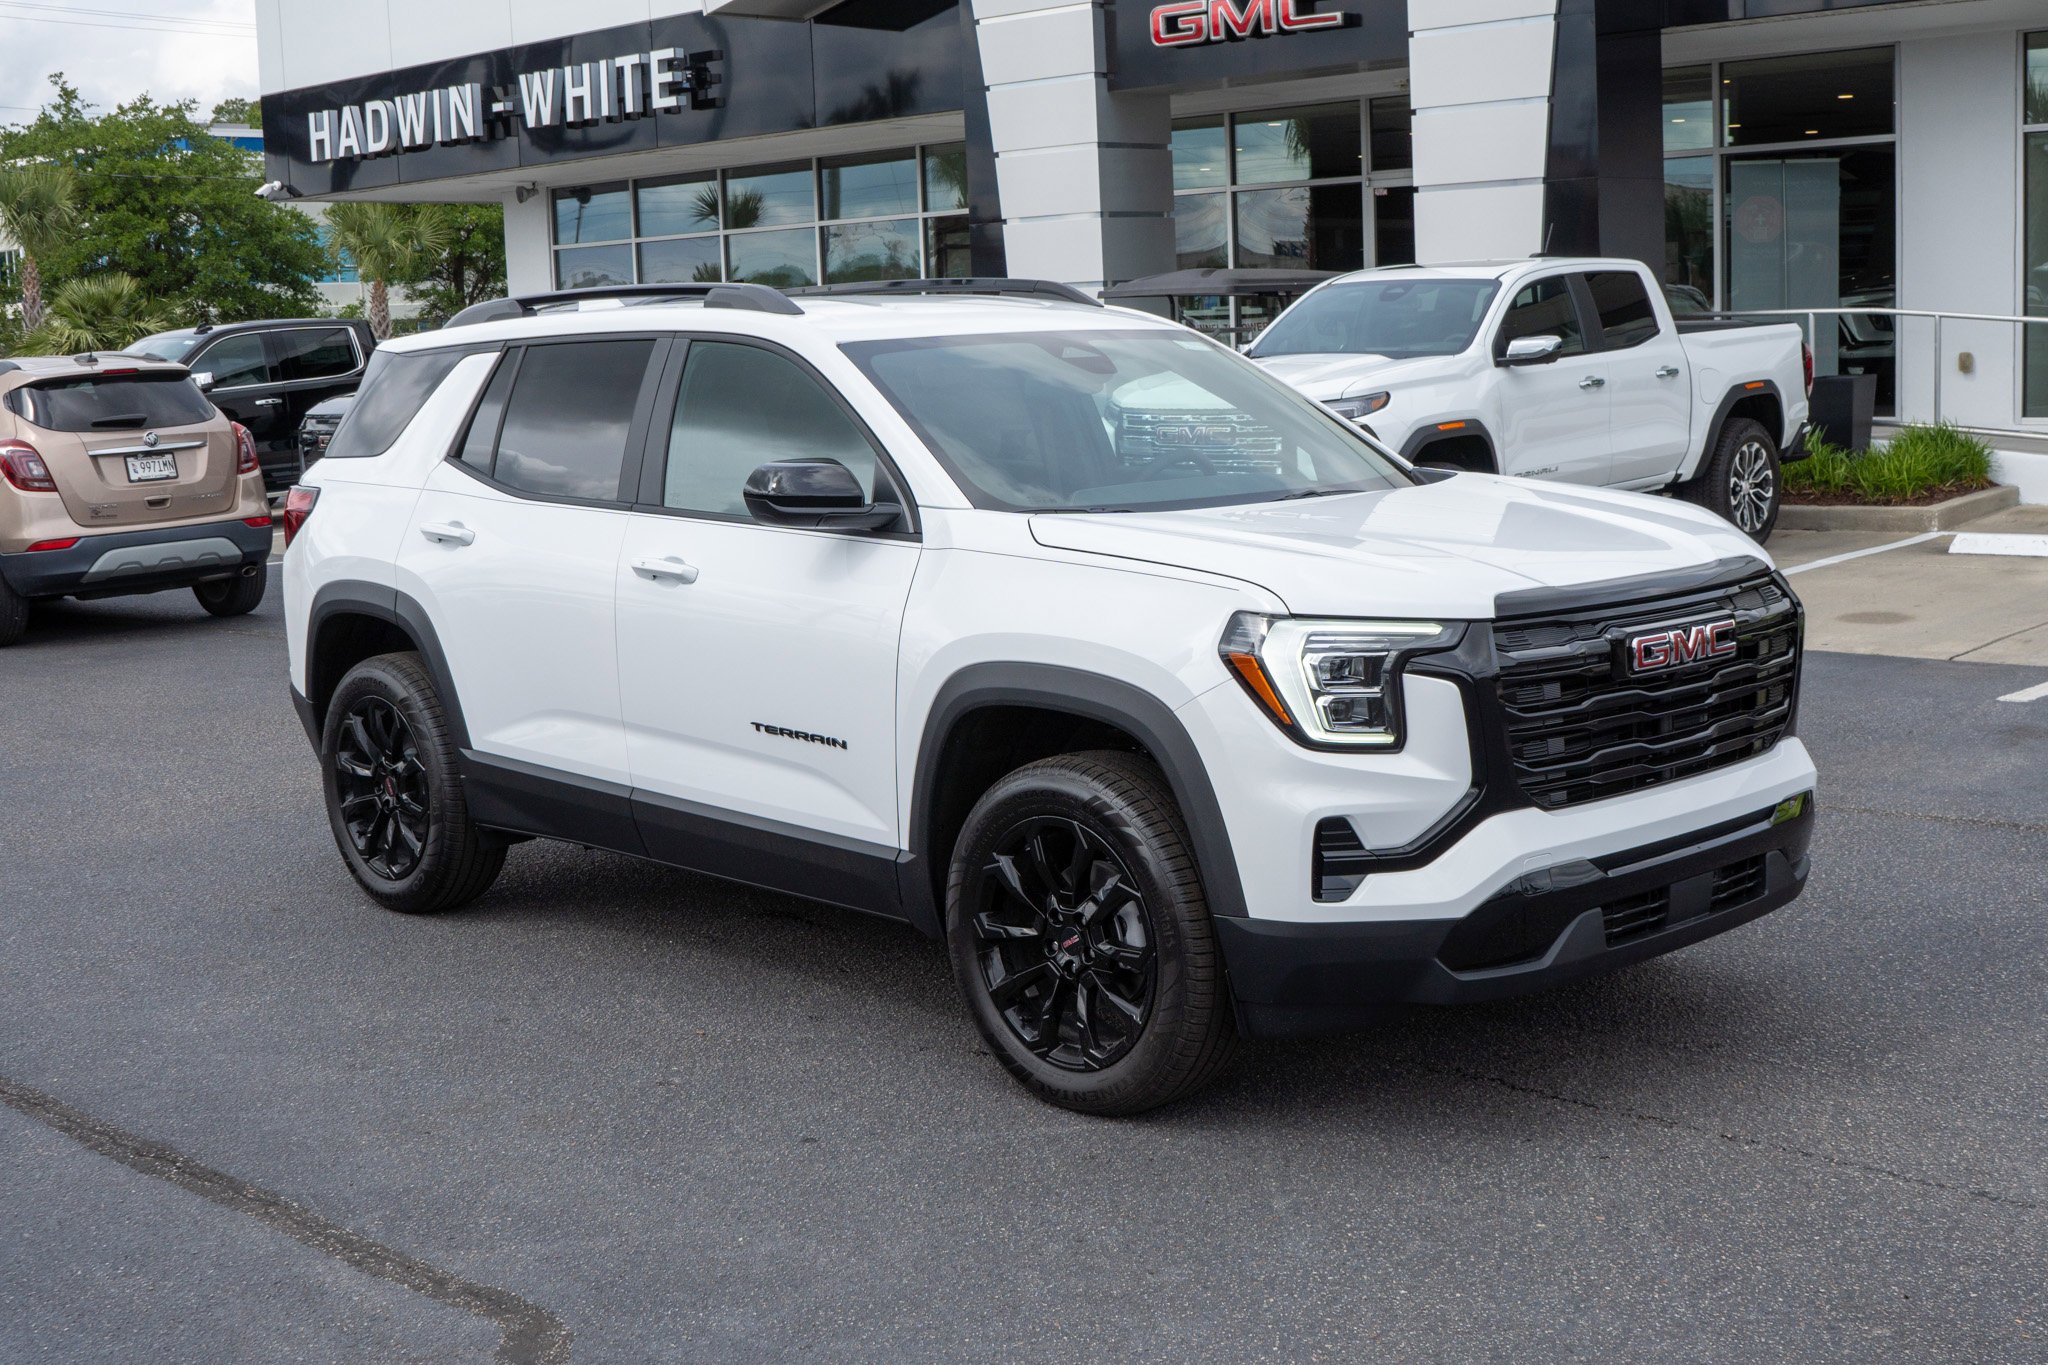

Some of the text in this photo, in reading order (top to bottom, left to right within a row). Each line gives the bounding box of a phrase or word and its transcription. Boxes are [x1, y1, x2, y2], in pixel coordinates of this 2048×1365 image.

[1150, 0, 1344, 46] GMC
[1157, 426, 1232, 445] GMC
[140, 459, 174, 473] 9971MN
[1631, 619, 1737, 671] GMC
[750, 721, 848, 750] TERRAIN
